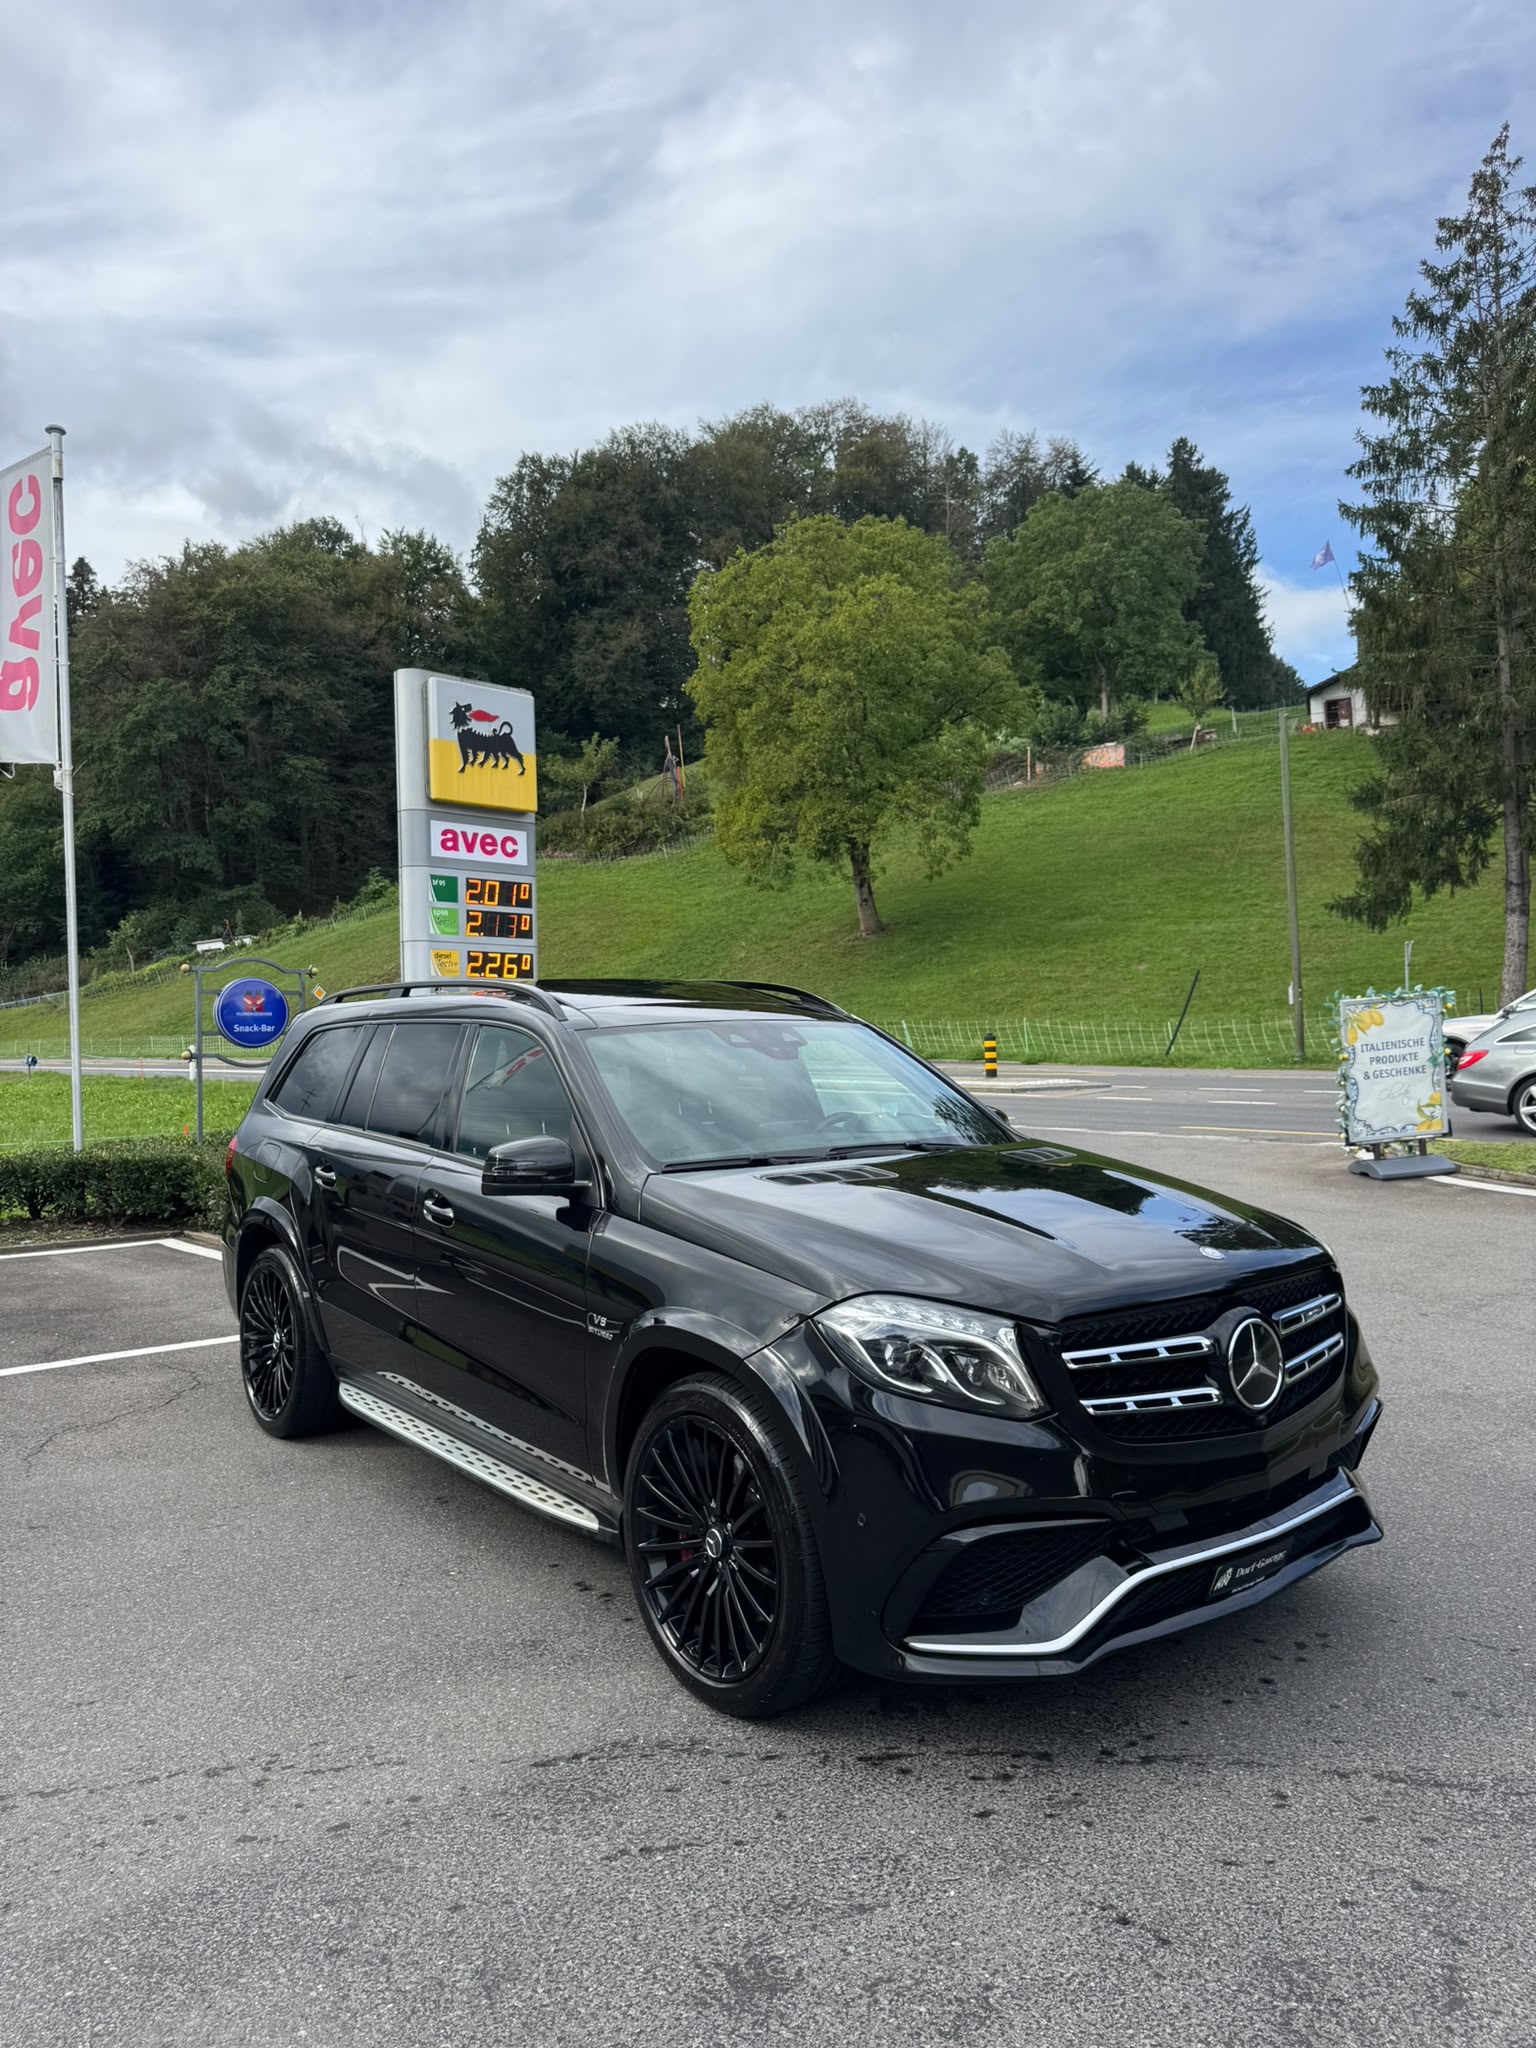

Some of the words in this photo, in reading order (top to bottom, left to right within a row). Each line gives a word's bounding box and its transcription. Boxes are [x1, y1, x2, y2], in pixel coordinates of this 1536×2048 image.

[440, 828, 519, 859] avec
[434, 951, 451, 959] diesel
[233, 1024, 275, 1032] Snack-Bar
[1360, 1037, 1425, 1053] ITALIENISCHE
[1369, 1052, 1419, 1066] PRODUKTE
[1363, 1071, 1370, 1080] &
[1372, 1064, 1427, 1079] GESCHENKE
